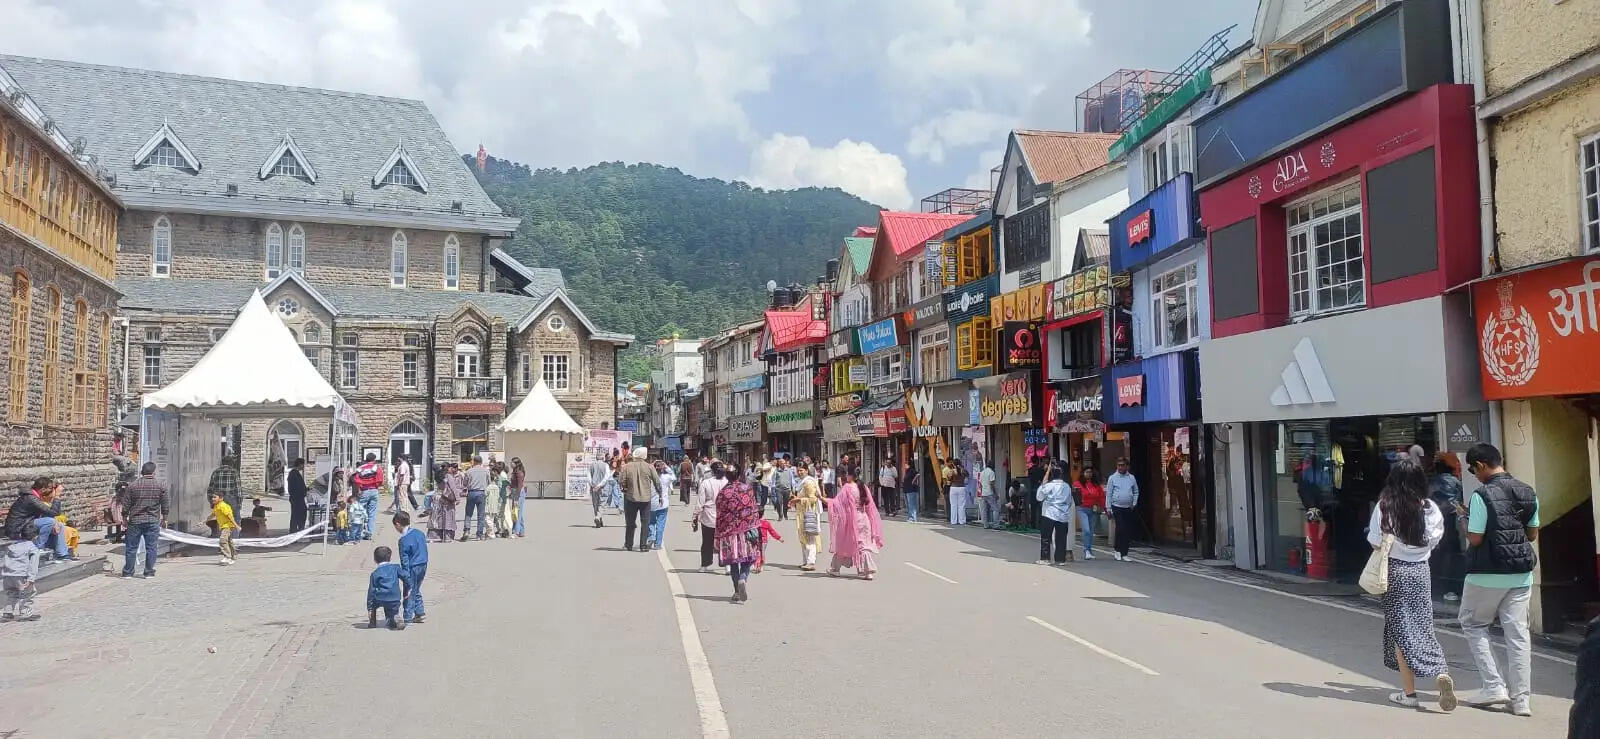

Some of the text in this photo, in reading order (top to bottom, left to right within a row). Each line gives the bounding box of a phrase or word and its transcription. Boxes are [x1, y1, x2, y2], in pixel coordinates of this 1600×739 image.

[1274, 151, 1308, 184] ADA
[1009, 349, 1040, 358] xero
[1010, 357, 1040, 366] degrees
[1001, 378, 1027, 397] xero
[981, 395, 1028, 422] degrees
[1056, 394, 1103, 414] Hideout Café
